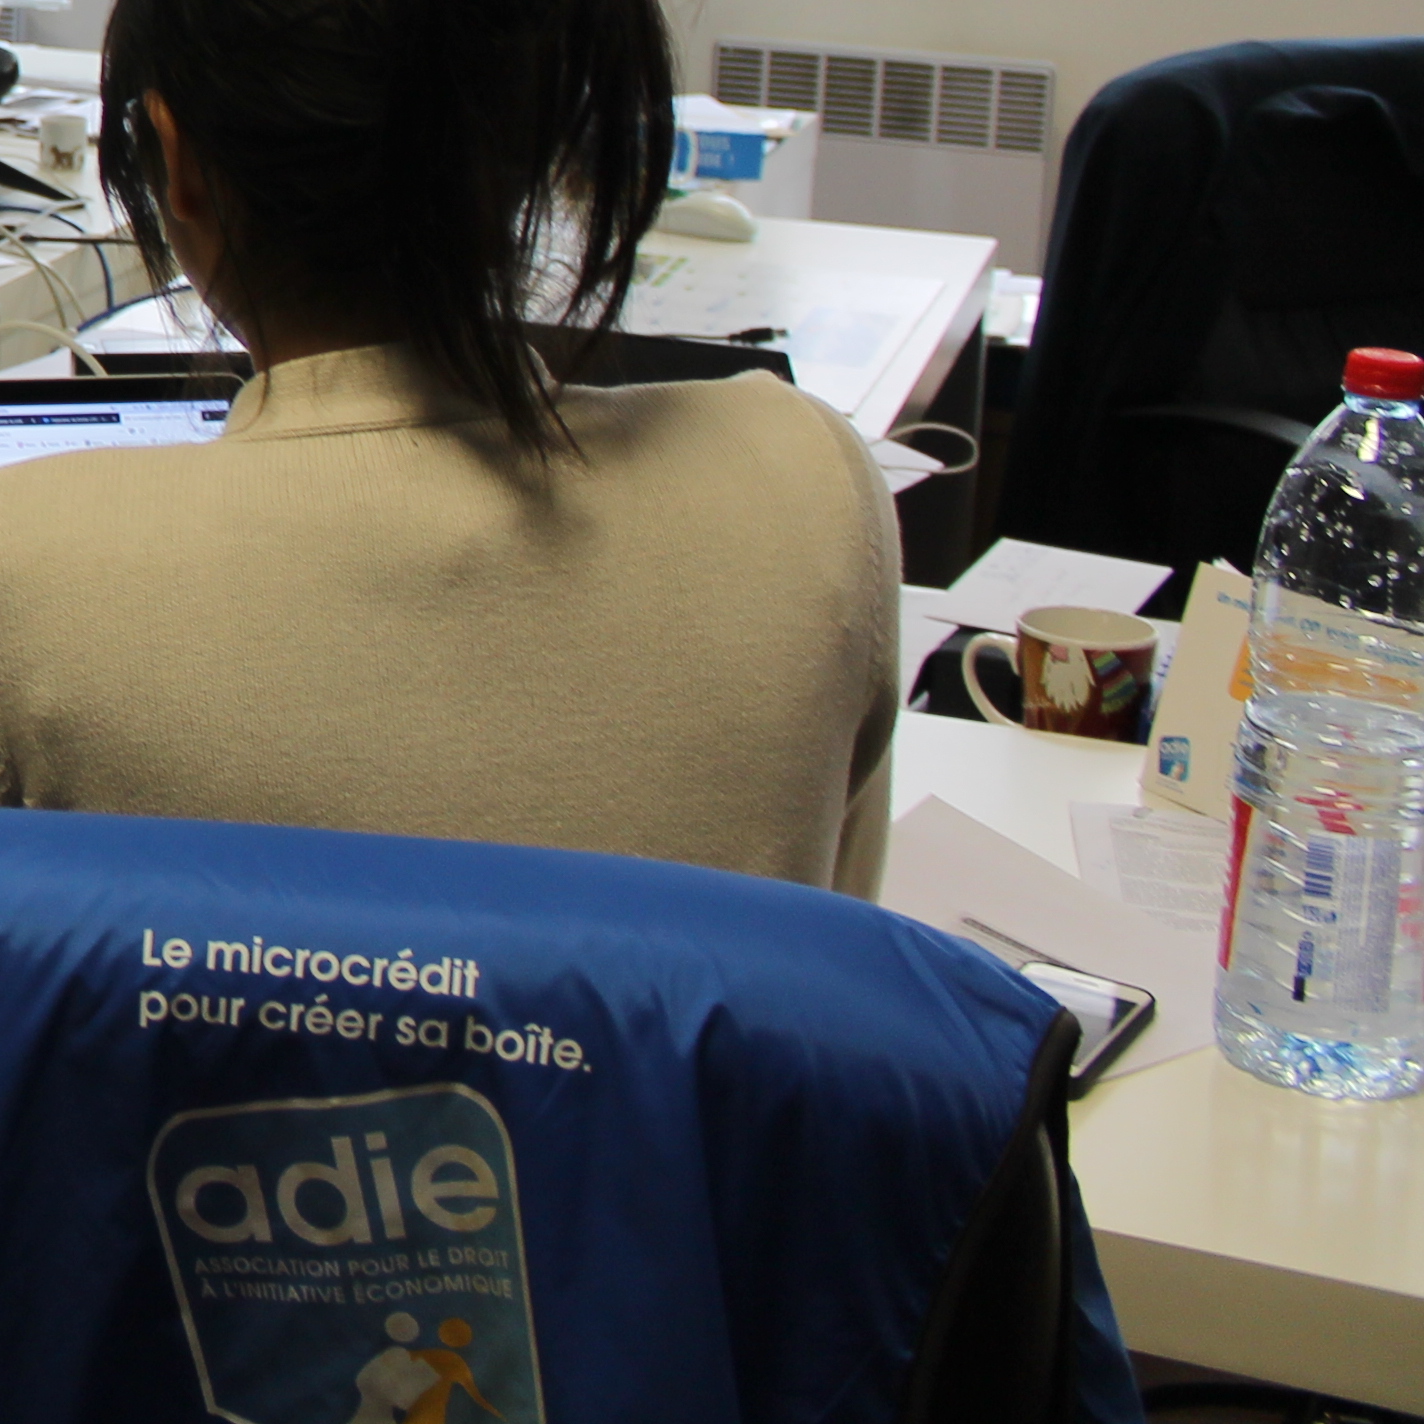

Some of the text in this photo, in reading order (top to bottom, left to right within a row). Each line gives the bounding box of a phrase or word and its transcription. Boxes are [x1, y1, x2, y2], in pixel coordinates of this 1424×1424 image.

[141, 928, 480, 999] Le microcrédit
[139, 989, 594, 1073] pour créer sa boîte.
[174, 1131, 500, 1247] adie
[194, 1246, 510, 1279] ASSOCIATION POUR LE DROIT
[200, 1271, 515, 1306] À L'INITIATIVE ÉCONOMIQUE
